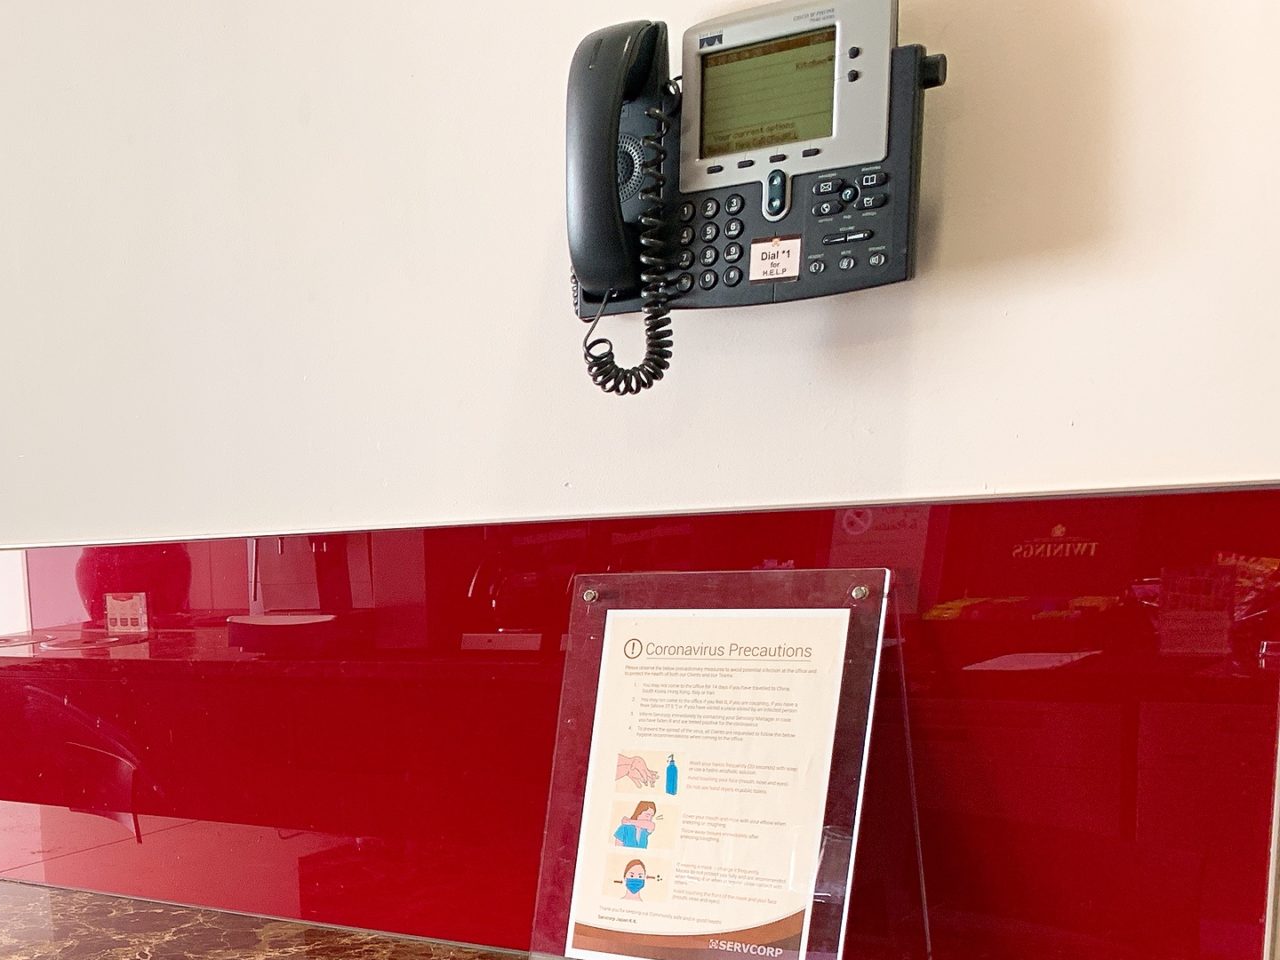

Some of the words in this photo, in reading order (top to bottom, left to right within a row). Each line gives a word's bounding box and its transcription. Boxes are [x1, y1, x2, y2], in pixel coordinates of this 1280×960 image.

[761, 251, 779, 261] Dial
[646, 642, 725, 657] Coronavirus
[728, 643, 813, 659] Precautions
[719, 940, 783, 957] SERVCORP
